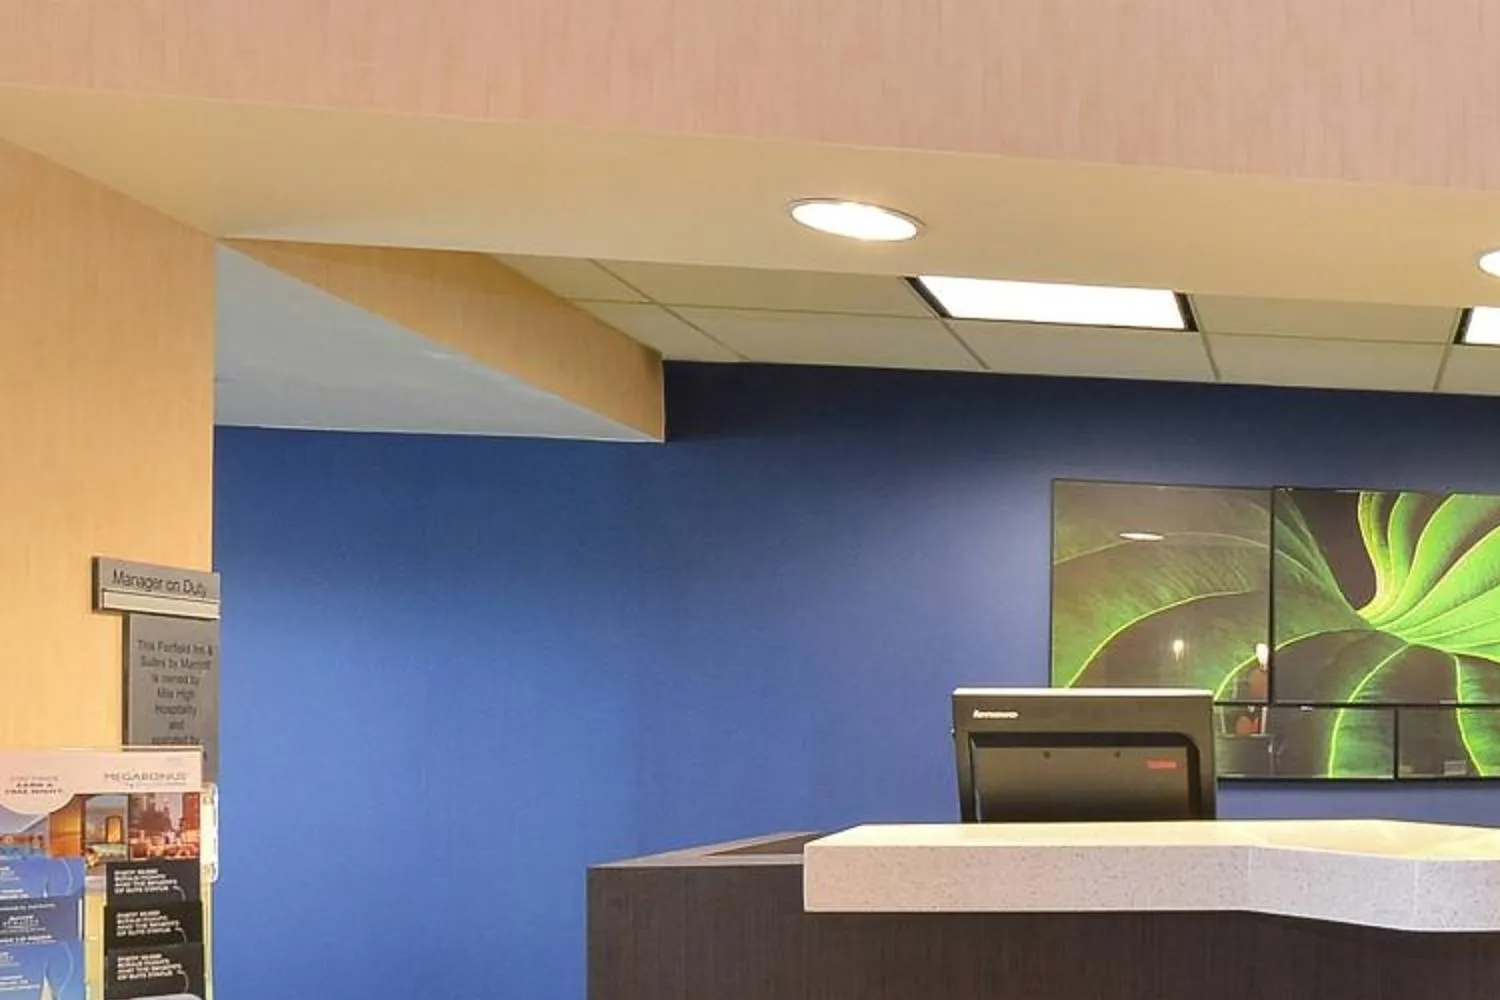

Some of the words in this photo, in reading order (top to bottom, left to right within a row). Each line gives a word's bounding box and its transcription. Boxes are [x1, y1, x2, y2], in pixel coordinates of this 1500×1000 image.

[111, 568, 163, 592] Manager
[165, 580, 181, 593] on
[183, 579, 208, 600] Duty
